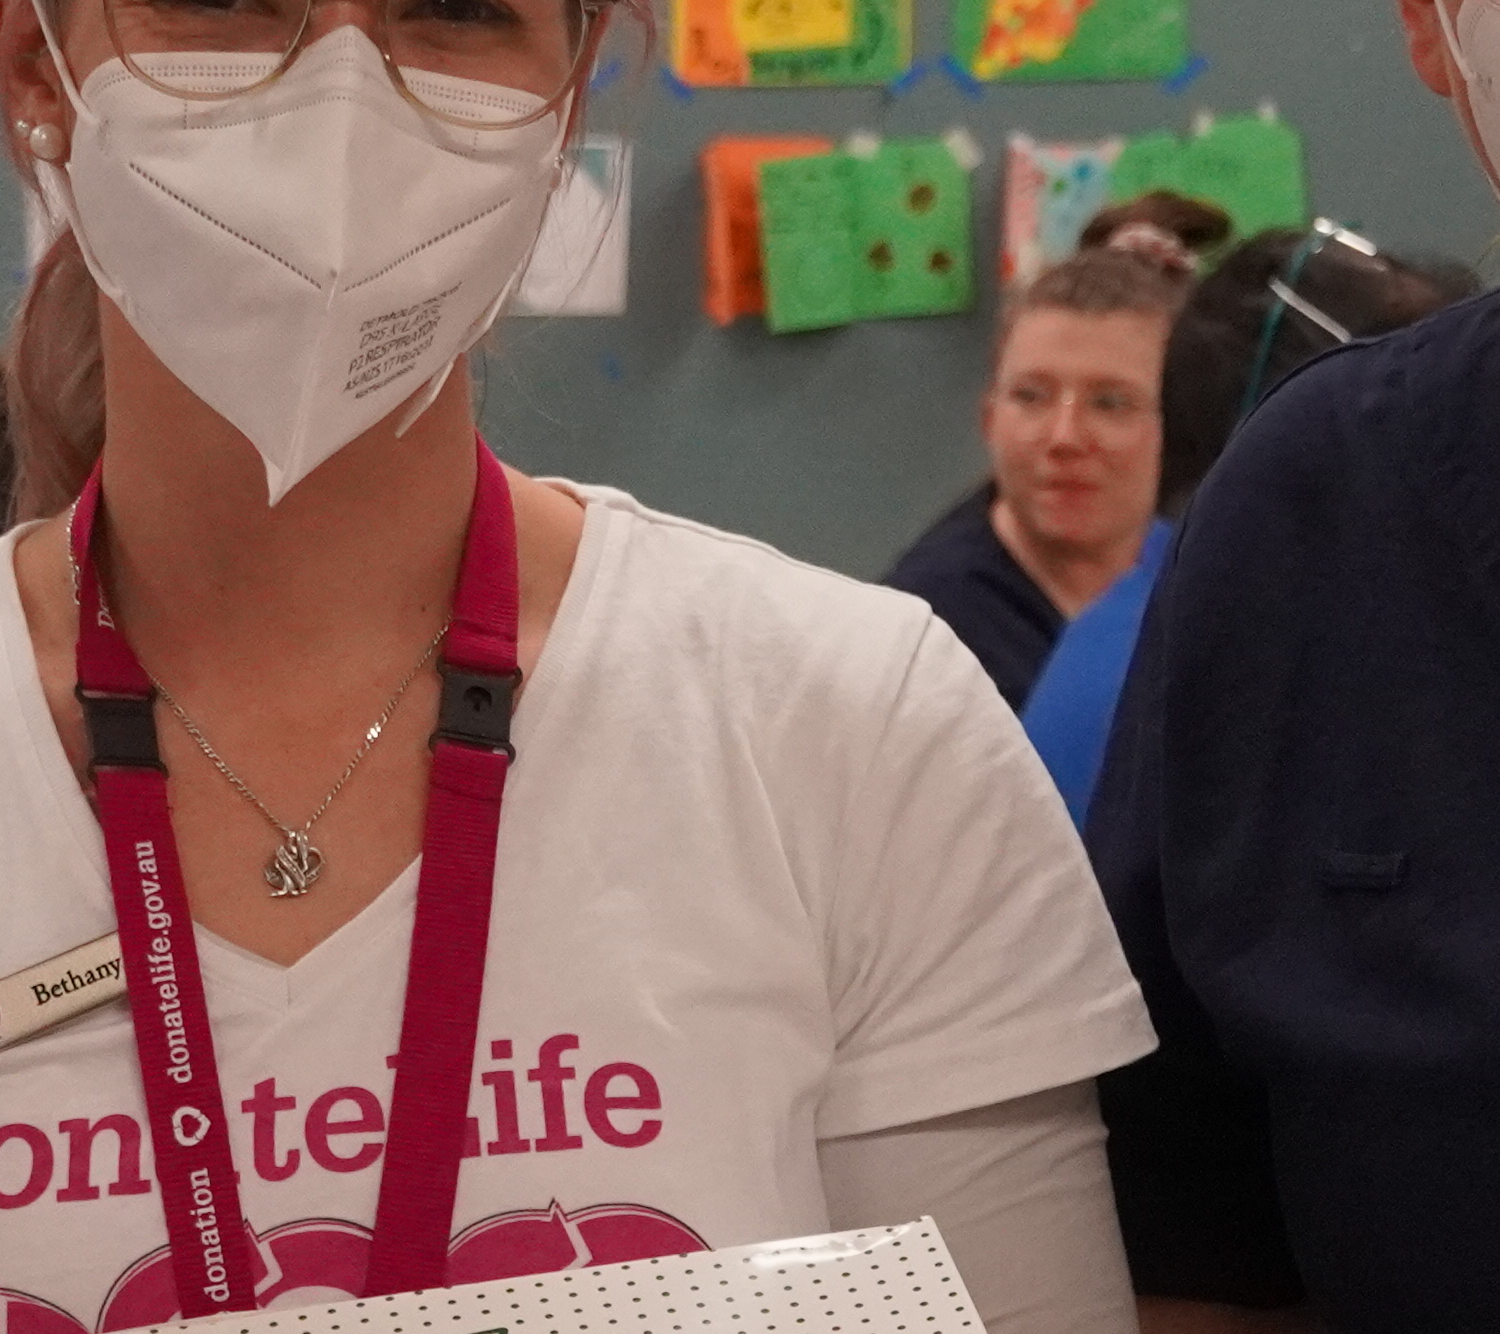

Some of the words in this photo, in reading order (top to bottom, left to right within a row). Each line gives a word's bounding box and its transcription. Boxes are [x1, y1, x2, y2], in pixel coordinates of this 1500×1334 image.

[30, 957, 122, 1006] Bethany
[134, 839, 194, 1085] donatelife.gov.au
[189, 1166, 231, 1305] donation
